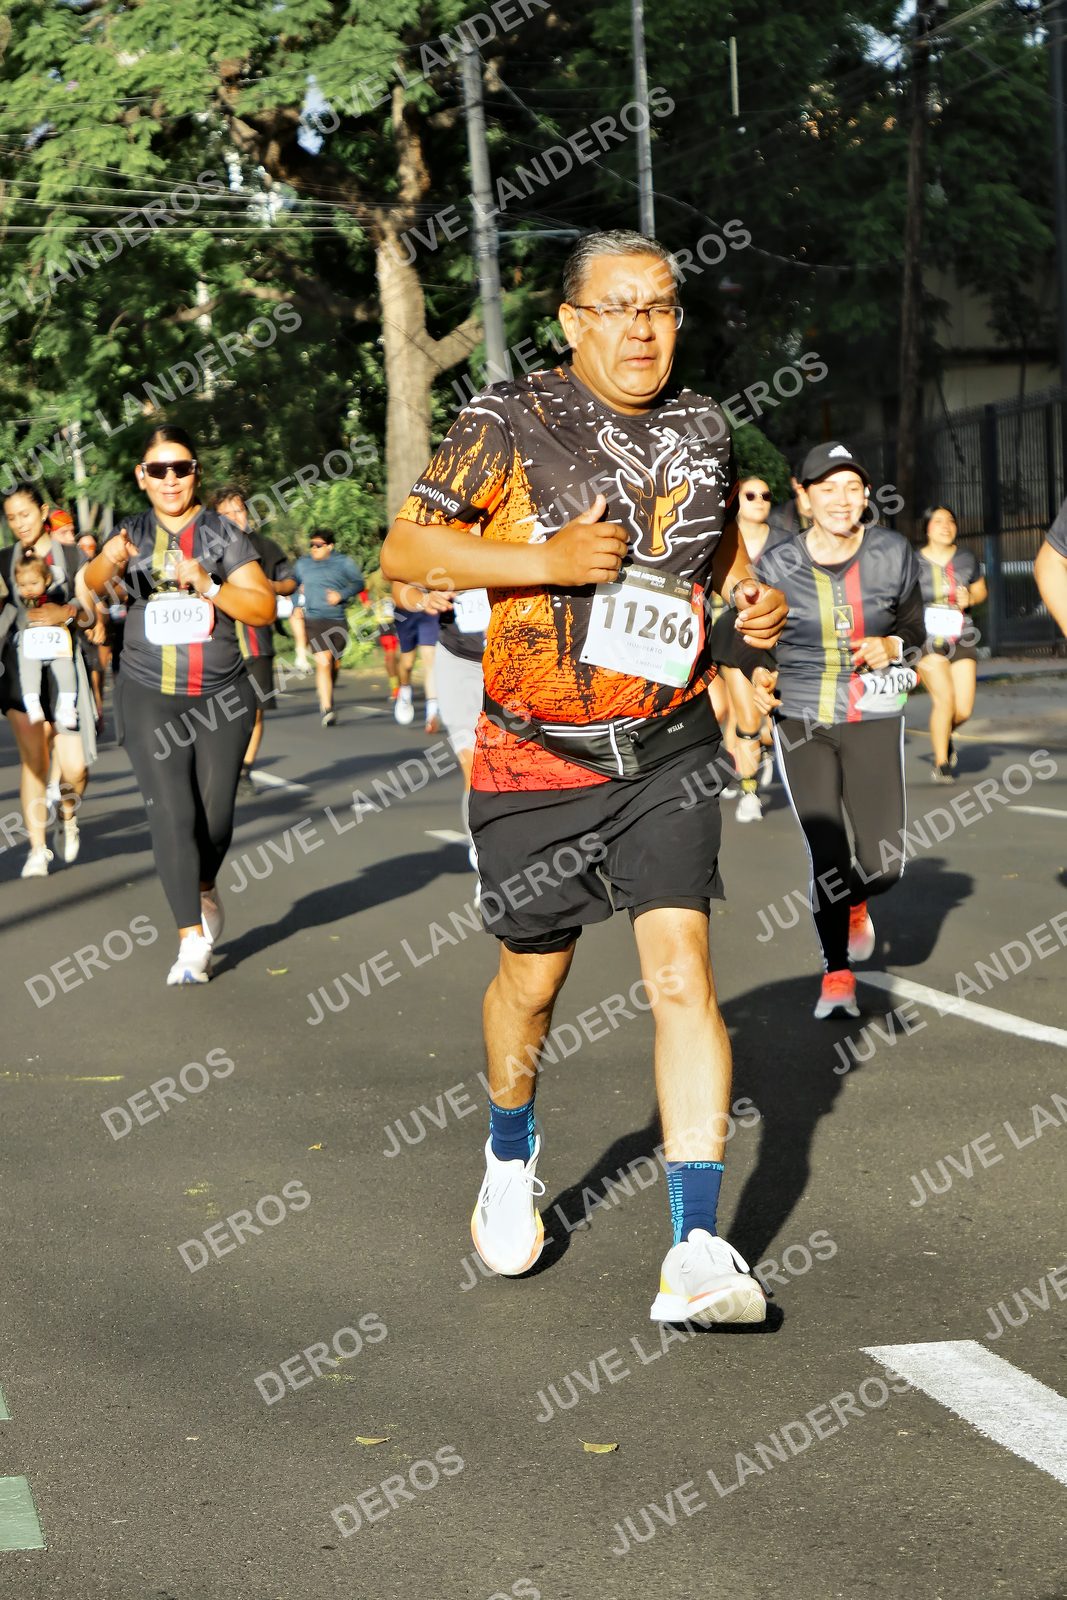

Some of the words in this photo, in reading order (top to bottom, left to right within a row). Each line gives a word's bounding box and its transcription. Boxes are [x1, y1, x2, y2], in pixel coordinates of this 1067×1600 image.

[150, 606, 204, 625] 13095
[602, 595, 693, 650] 11266
[870, 672, 913, 695] 12188
